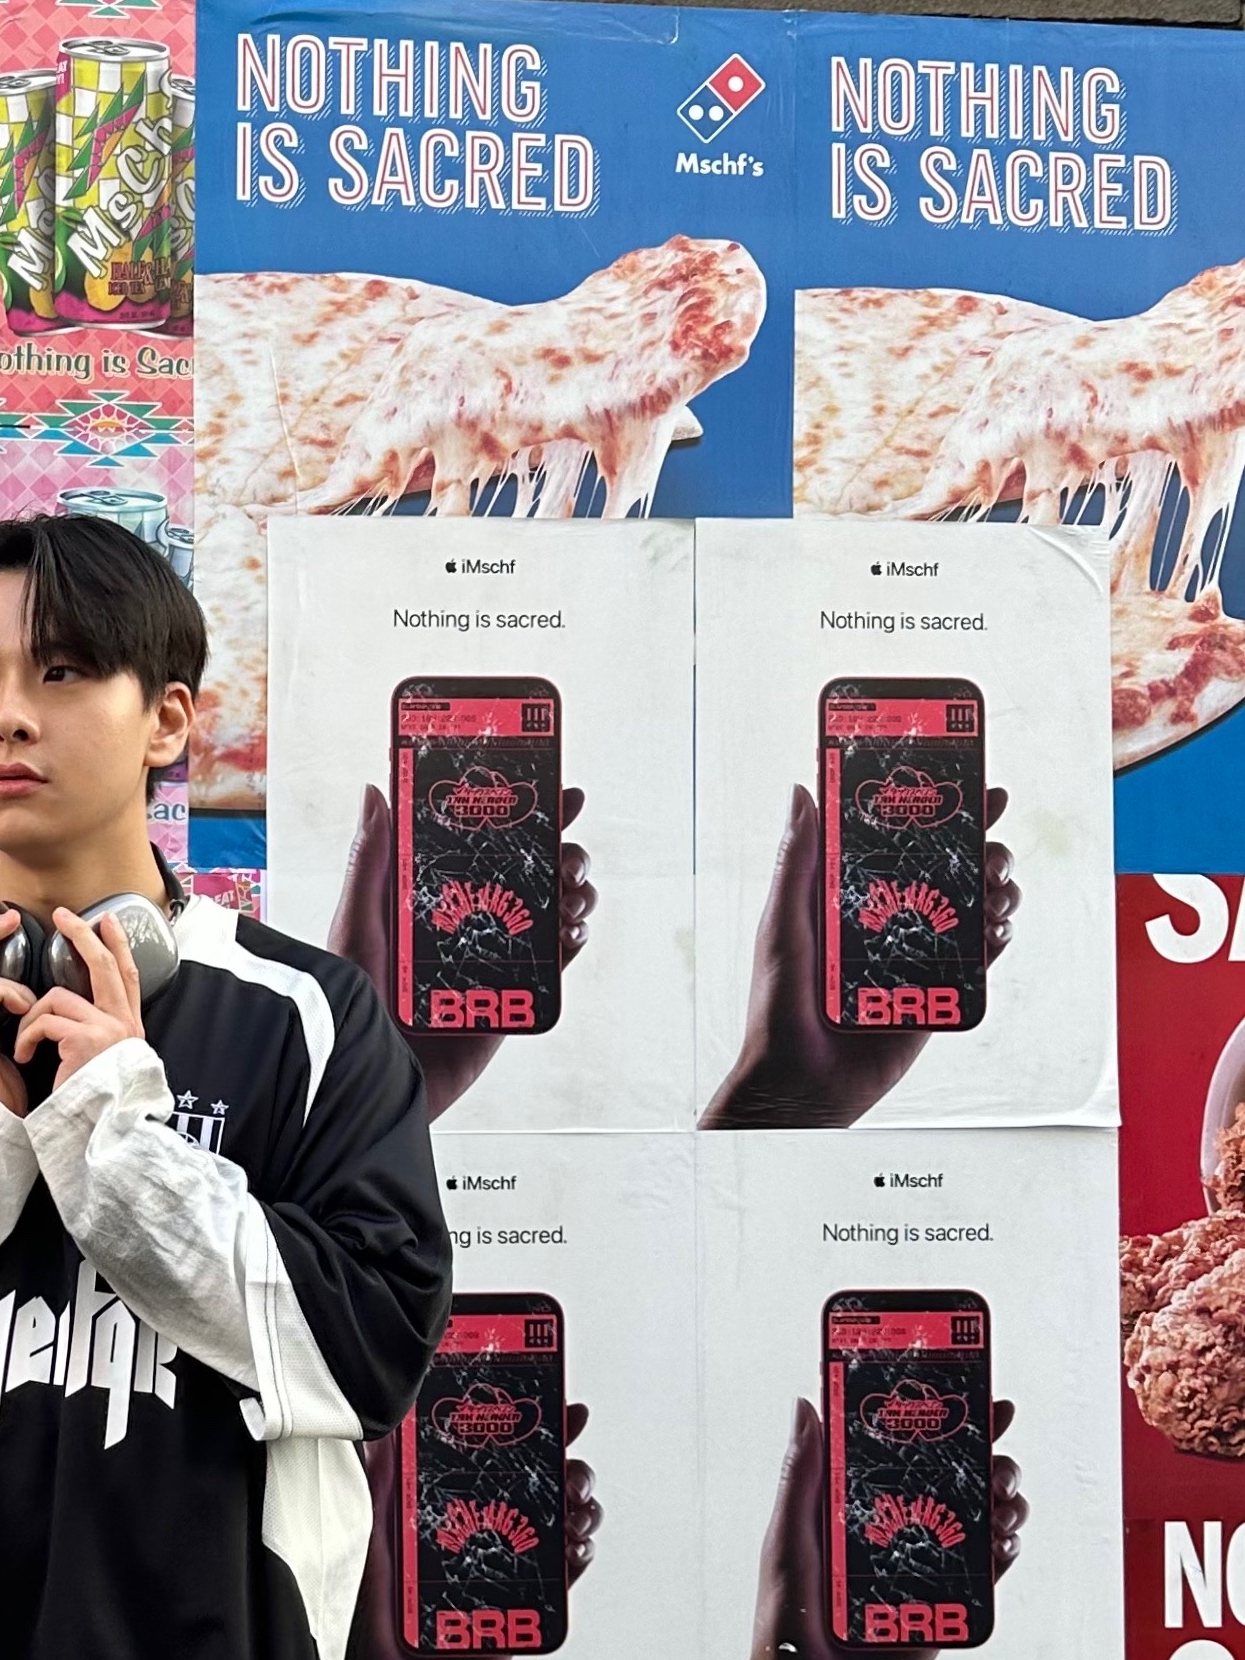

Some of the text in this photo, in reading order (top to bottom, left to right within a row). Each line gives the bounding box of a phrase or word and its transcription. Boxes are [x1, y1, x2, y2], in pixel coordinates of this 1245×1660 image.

[237, 34, 542, 121] NOTHING
[831, 57, 1121, 143] NOTHING
[237, 123, 595, 213] IS SACRED
[676, 152, 764, 177] Mschf's
[831, 143, 1172, 232] IS SACRED
[103, 355, 126, 373] is
[462, 559, 516, 574] iMschf
[887, 561, 939, 577] iMschf
[393, 609, 566, 632] Nothing is sacred.
[820, 610, 987, 634] Nothing is sacred.
[430, 989, 535, 1028] BRB
[858, 987, 961, 1025] BRB
[463, 1175, 517, 1191] iMschf
[890, 1173, 944, 1188] iMschf
[477, 1230, 492, 1245] is
[498, 1225, 567, 1245] sacred.
[823, 1223, 993, 1246] Nothing is sacred.
[436, 1609, 541, 1650] BRB
[865, 1603, 968, 1643] BRB
